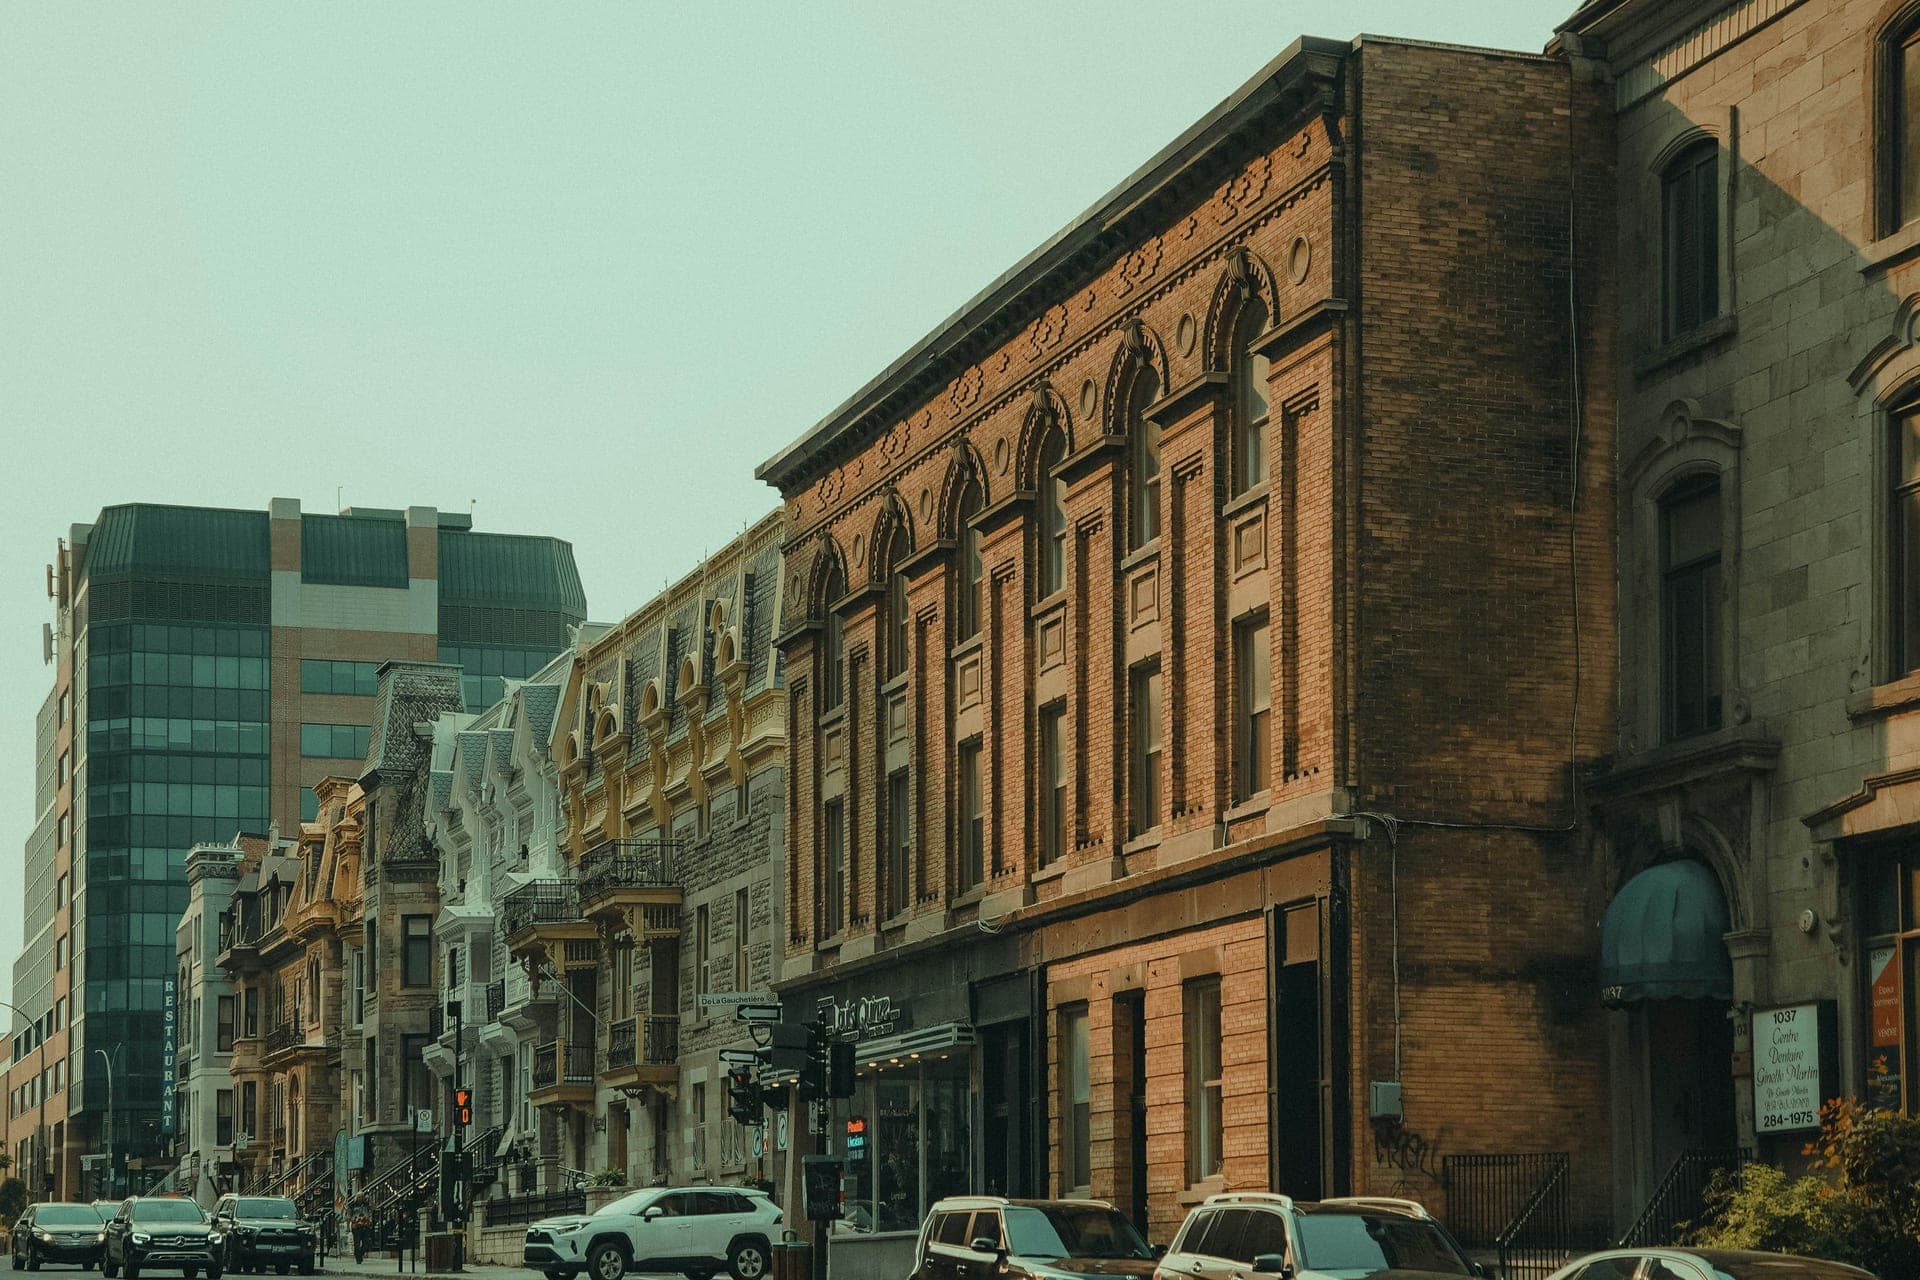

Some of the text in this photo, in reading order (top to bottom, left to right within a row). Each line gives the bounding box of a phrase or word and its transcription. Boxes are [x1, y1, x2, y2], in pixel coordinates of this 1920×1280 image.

[1773, 1010, 1797, 1024] 1037
[1772, 1027, 1799, 1045] Centre
[163, 981, 173, 1127] RESTAURANT
[1769, 1046, 1804, 1064] Dentaire
[1786, 1065, 1818, 1081] Martin
[1764, 1111, 1813, 1128] 284-1975
